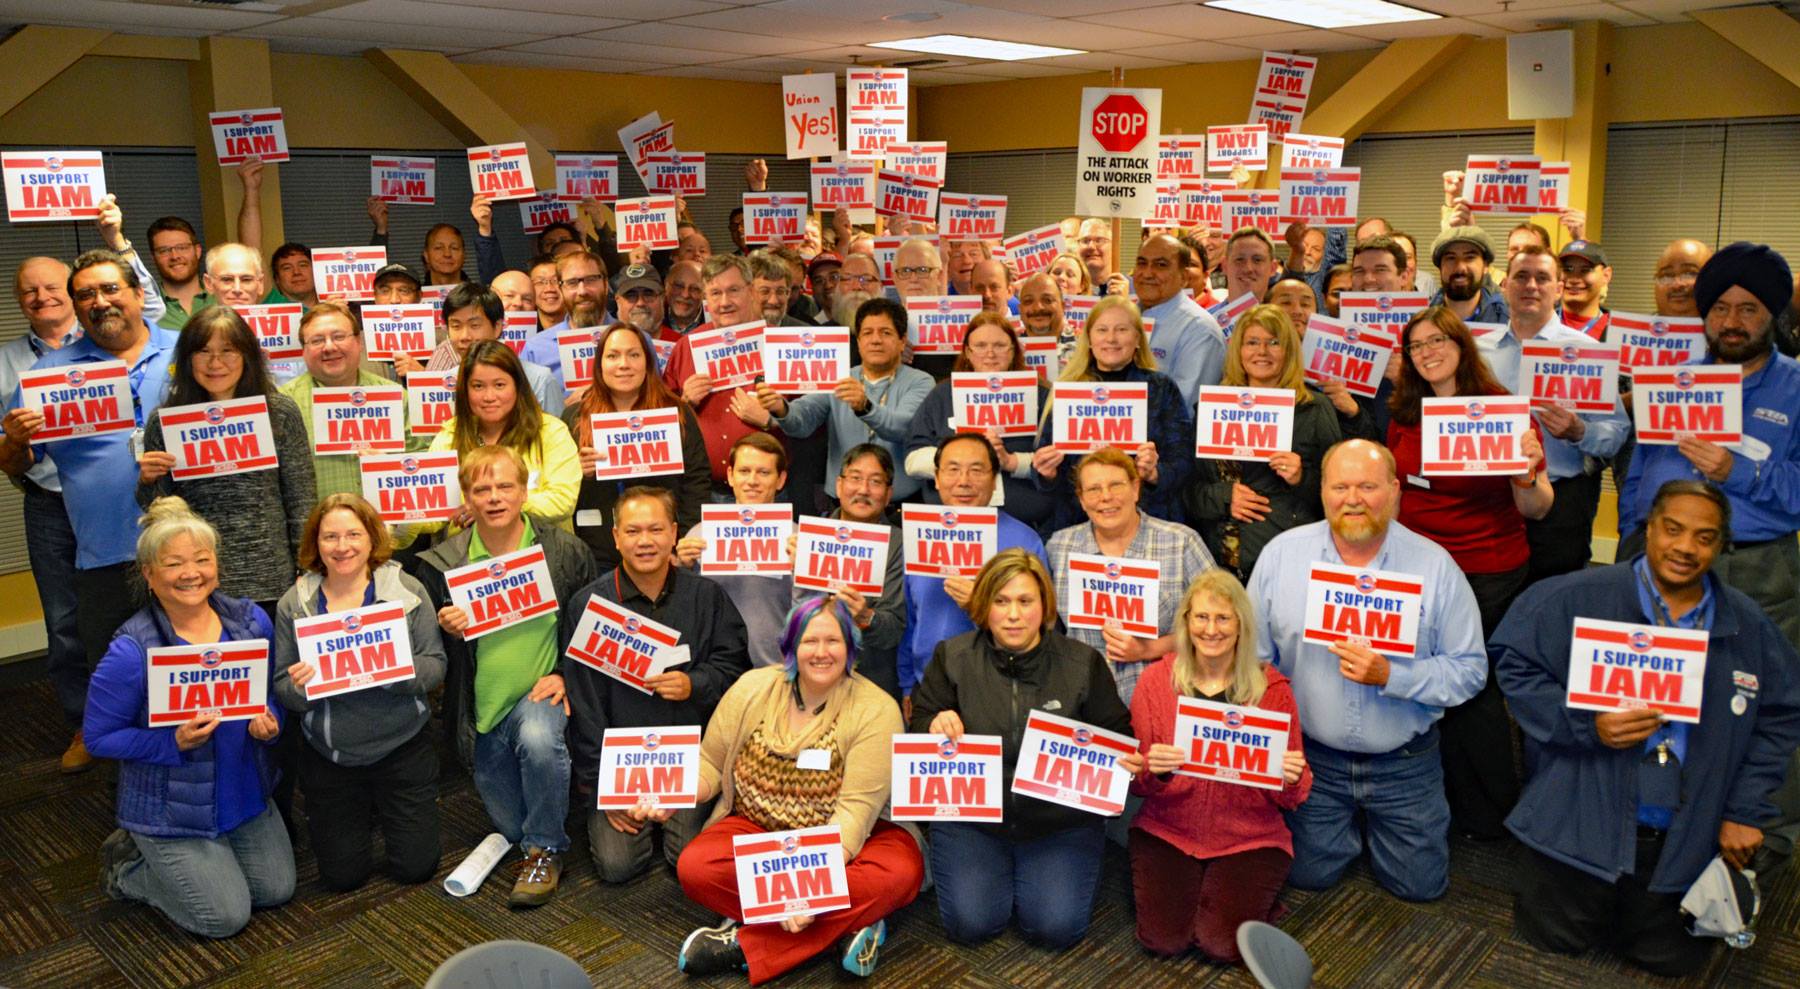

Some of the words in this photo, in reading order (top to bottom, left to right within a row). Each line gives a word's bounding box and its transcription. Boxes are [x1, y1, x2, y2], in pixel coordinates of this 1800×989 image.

[1274, 67, 1304, 78] SUPPORT
[1267, 72, 1302, 92] IAM
[786, 93, 820, 106] Union
[1095, 112, 1145, 135] STOP
[1264, 111, 1293, 121] SUPPORT
[223, 129, 228, 137] I
[230, 125, 273, 137] SUPPORT
[226, 135, 277, 156] IAM
[1217, 133, 1257, 148] IAM
[1217, 149, 1252, 157] SUPPORT
[481, 161, 519, 173] SUPPORT
[661, 166, 696, 174] SUPPORT
[1088, 157, 1106, 168] THE
[1109, 158, 1148, 169] ATTACK
[20, 174, 26, 185] I
[29, 174, 88, 185] SUPPORT
[387, 171, 425, 180] SUPPORT
[478, 170, 524, 192] IAM
[571, 170, 609, 178] SUPPORT
[657, 174, 696, 188] IAM
[826, 178, 864, 186] SUPPORT
[1083, 171, 1100, 182] ON
[1104, 172, 1152, 184] WORKER
[1476, 174, 1480, 183] I
[1482, 174, 1528, 184] SUPPORT
[382, 180, 426, 196] IAM
[567, 179, 609, 194] IAM
[821, 187, 864, 202] IAM
[890, 185, 928, 198] SUPPORT
[1097, 186, 1136, 197] RIGHTS
[1291, 185, 1296, 195] I
[1298, 186, 1346, 196] SUPPORT
[1474, 185, 1527, 205] IAM
[22, 186, 92, 208] IAM
[884, 194, 926, 214] IAM
[1191, 195, 1221, 204] SUPPOR
[1291, 196, 1346, 216] IAM
[629, 213, 666, 224] SUPPORT
[759, 208, 798, 217] SUPPORT
[956, 209, 996, 218] SUPPORT
[1186, 204, 1222, 221] IAM
[1237, 206, 1278, 215] SUPPORT
[626, 223, 668, 242] IAM
[754, 218, 798, 234] IAM
[950, 218, 995, 234] IAM
[1019, 240, 1055, 256] SUPPORT
[331, 264, 376, 274] SUPPORT
[326, 273, 376, 292] IAM
[379, 322, 422, 332] SUPPORT
[925, 314, 971, 324] SUPPORT
[1354, 313, 1358, 323] I
[375, 332, 425, 351] IAM
[705, 351, 710, 360] I
[712, 341, 758, 359] SUPPORT
[1316, 337, 1323, 348] I
[1324, 339, 1378, 362] SUPPORT
[1622, 334, 1627, 343] I
[1631, 335, 1692, 349] SUPPORT
[785, 349, 836, 359] SUPPORT
[1620, 345, 1690, 366] IAM
[708, 351, 764, 380] IAM
[779, 361, 837, 382] IAM
[1310, 350, 1373, 383] IAM
[1534, 362, 1539, 373] I
[1543, 363, 1603, 376] SUPPORT
[40, 393, 47, 404] I
[50, 384, 114, 403] SUPPORT
[1533, 375, 1602, 400] IAM
[973, 392, 1024, 404] SUPPORT
[1648, 391, 1653, 403] I
[1657, 391, 1724, 403] SUPPORT
[43, 397, 119, 429] IAM
[327, 409, 332, 419] I
[335, 407, 390, 419] SUPPORT
[967, 404, 1025, 426] IAM
[1068, 405, 1072, 416] I
[1076, 406, 1133, 416] SUPPORT
[1213, 409, 1217, 420] I
[1221, 410, 1278, 423] SUPPORT
[1649, 405, 1723, 431] IAM
[180, 430, 186, 442] I
[189, 421, 254, 441] SUPPORT
[328, 419, 391, 442] IAM
[1068, 418, 1132, 441] IAM
[1212, 422, 1277, 448] IAM
[1439, 422, 1443, 434] I
[1448, 421, 1512, 434] SUPPORT
[607, 435, 611, 445] I
[614, 430, 666, 444] SUPPORT
[183, 434, 260, 469] IAM
[608, 442, 669, 466] IAM
[1439, 435, 1513, 460] IAM
[377, 478, 382, 488] I
[386, 473, 444, 488] SUPPORT
[379, 486, 448, 512] IAM
[716, 527, 720, 537] I
[724, 527, 778, 538] SUPPORT
[918, 528, 922, 538] I
[925, 528, 982, 541] SUPPORT
[717, 539, 779, 562] IAM
[811, 540, 815, 551] I
[818, 541, 874, 558] SUPPORT
[918, 541, 982, 566] IAM
[809, 553, 872, 584] IAM
[467, 590, 474, 601] I
[475, 570, 534, 598] SUPPORT
[1082, 578, 1087, 589] I
[1090, 579, 1144, 596] SUPPORT
[471, 582, 542, 623] IAM
[1083, 591, 1144, 622] IAM
[1325, 590, 1330, 602] I
[1335, 591, 1403, 612] SUPPORT
[1322, 604, 1401, 640] IAM
[316, 642, 323, 654] I
[326, 628, 391, 652] SUPPORT
[593, 621, 601, 631] I
[601, 624, 658, 656] SUPPORT
[319, 642, 397, 681] IAM
[584, 632, 652, 678] IAM
[1593, 649, 1599, 662] I
[1604, 650, 1684, 672] SUPPORT
[169, 672, 175, 684] I
[179, 667, 250, 684] SUPPORT
[1590, 665, 1682, 703] IAM
[169, 680, 250, 711] IAM
[1193, 725, 1198, 736] I
[1202, 726, 1271, 748] SUPPORT
[616, 753, 621, 765] I
[625, 752, 684, 766] SUPPORT
[1040, 739, 1046, 751] I
[1049, 741, 1116, 768] SUPPORT
[1191, 738, 1269, 773] IAM
[910, 762, 915, 775] I
[919, 762, 986, 775] SUPPORT
[1033, 753, 1112, 797] IAM
[615, 767, 684, 794] IAM
[910, 777, 985, 805] IAM
[753, 862, 759, 875] I
[762, 853, 827, 873] SUPPORT
[755, 868, 833, 904] IAM
